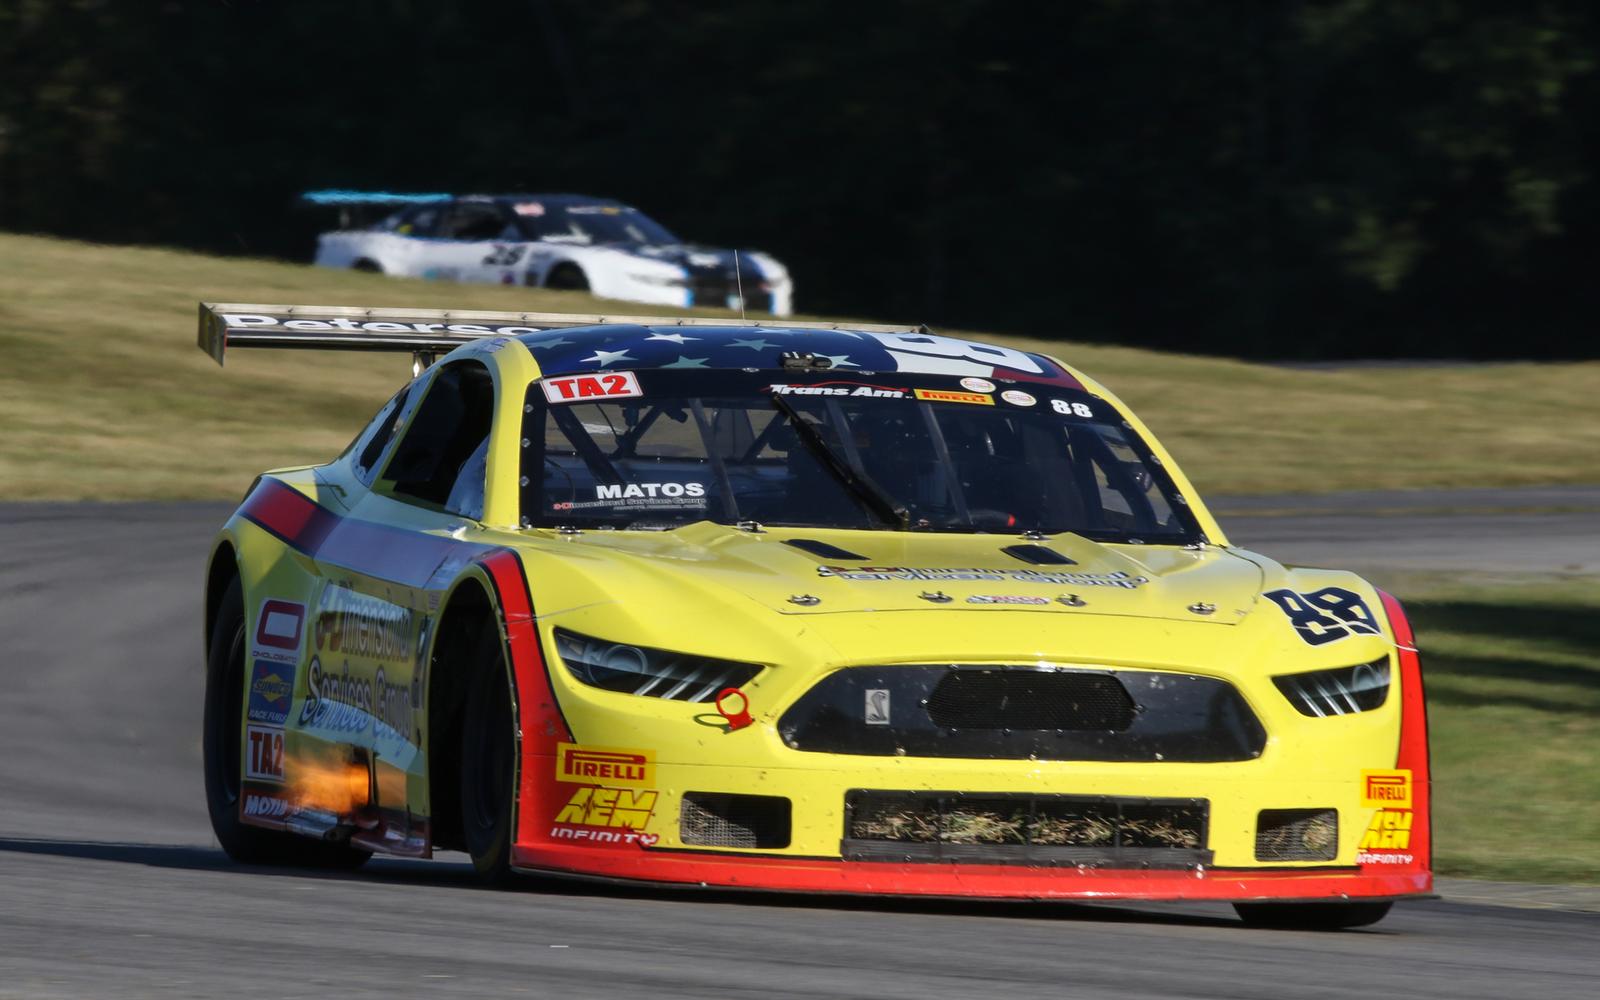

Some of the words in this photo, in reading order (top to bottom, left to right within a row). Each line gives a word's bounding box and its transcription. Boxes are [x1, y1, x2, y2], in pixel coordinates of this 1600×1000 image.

[550, 373, 632, 399] TA2
[769, 384, 850, 397] Trans
[851, 386, 904, 399] Am
[1050, 399, 1093, 418] 88
[596, 482, 705, 500] MATOS
[249, 730, 284, 778] TA2
[564, 749, 646, 781] PIRELLI
[1367, 775, 1406, 801] PIRELLI
[554, 787, 659, 831] AEM
[550, 827, 658, 846] INFINITY
[1358, 810, 1413, 850] AEM
